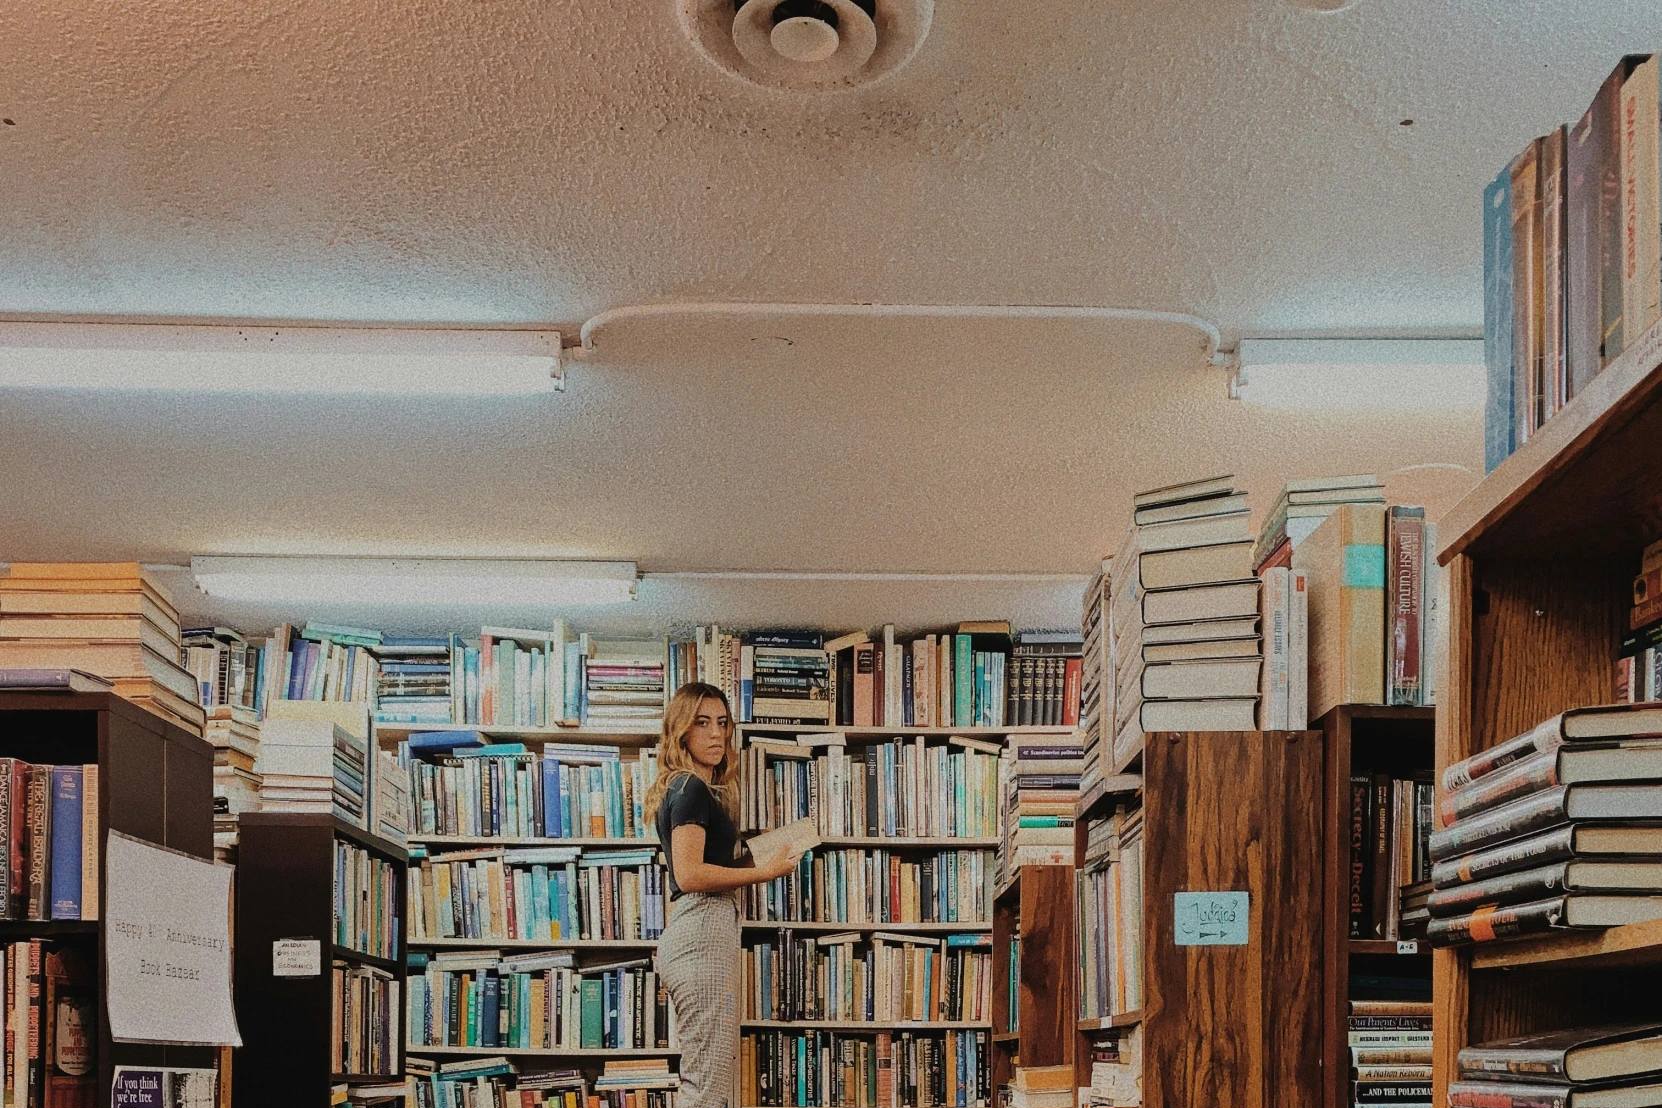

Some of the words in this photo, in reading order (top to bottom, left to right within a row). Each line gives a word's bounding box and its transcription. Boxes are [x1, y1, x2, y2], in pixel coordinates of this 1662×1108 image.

[1627, 174, 1636, 279] VICTORIES
[1400, 532, 1411, 566] JEWISH
[1399, 570, 1411, 614] CULTURE
[34, 779, 45, 801] THE
[34, 804, 44, 833] REAL
[1352, 786, 1365, 854] Secrecy
[29, 836, 43, 884] ISADORA
[1352, 862, 1364, 913] Deceit
[115, 918, 144, 939] Happy
[166, 928, 224, 952] Anniversary
[29, 943, 39, 975] PUPPETS
[140, 959, 161, 976] Book
[30, 983, 39, 998] AND
[28, 1006, 38, 1059] PUPPETEERING
[1368, 1016, 1398, 1027] Parents'
[1399, 1017, 1419, 1026] Lives
[117, 1076, 123, 1089] If
[125, 1078, 138, 1092] you
[140, 1077, 158, 1090] think
[117, 1090, 137, 1104] we're
[139, 1090, 153, 1103] free
[1383, 1088, 1397, 1096] THE
